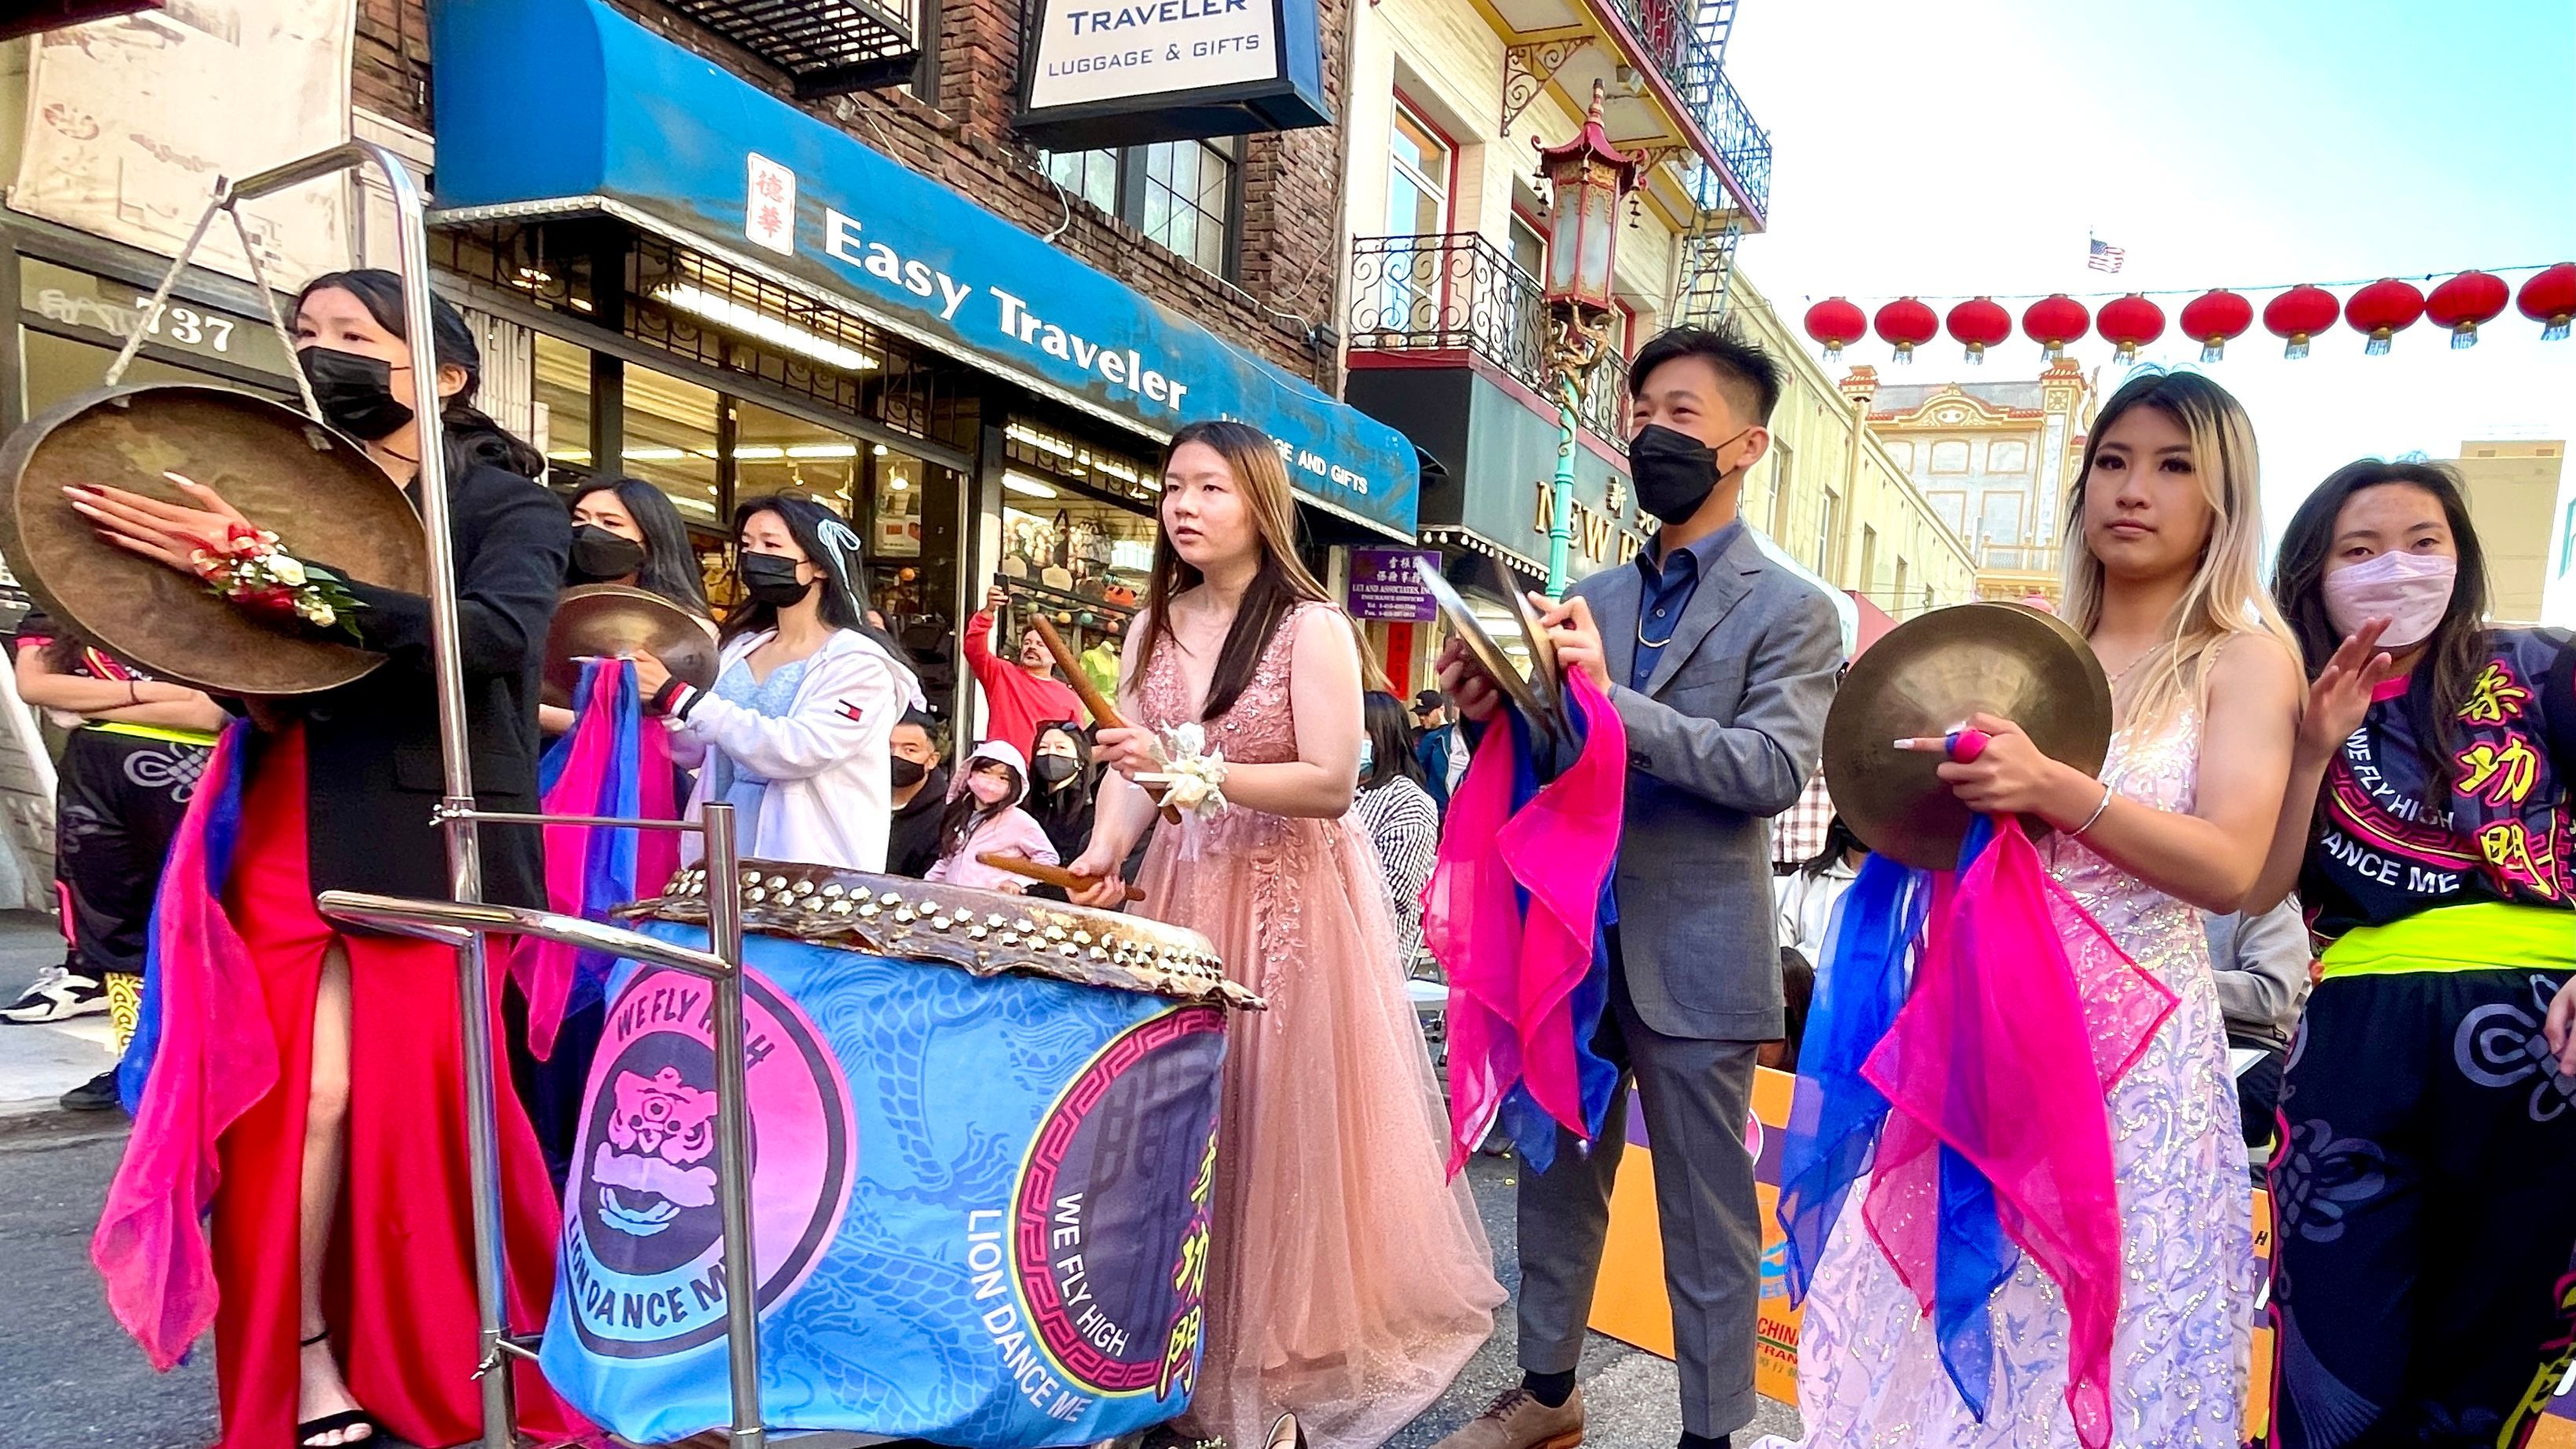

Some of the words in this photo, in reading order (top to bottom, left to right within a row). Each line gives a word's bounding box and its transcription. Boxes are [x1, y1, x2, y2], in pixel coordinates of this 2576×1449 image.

[1066, 0, 1248, 35] TRAVELER
[1048, 49, 1154, 77] LUGGAGE
[1165, 43, 1181, 61] &
[1193, 35, 1259, 57] GIFTS
[756, 170, 786, 239] 德華
[136, 296, 235, 353] 737
[825, 206, 972, 322] Easy
[990, 286, 1189, 412] Traveler
[1297, 449, 1328, 477] AND
[1330, 464, 1368, 495] GIFTS
[2345, 727, 2371, 762] WE
[2353, 765, 2395, 798] FLY
[2320, 827, 2402, 886] ANCE
[2407, 866, 2461, 894] ME
[617, 995, 648, 1042] WE
[651, 987, 701, 1024] FLY
[1051, 1191, 1084, 1250] WE
[568, 1214, 590, 1296] LION
[586, 1278, 689, 1329] DANCE
[689, 1255, 728, 1312] M
[967, 1210, 1007, 1301] LION
[1056, 1254, 1094, 1307] FLY
[981, 1301, 1061, 1410] DANCE
[1076, 1304, 1131, 1359] HIGH
[1757, 1317, 1799, 1347] CHIN
[1045, 1389, 1094, 1425] ME
